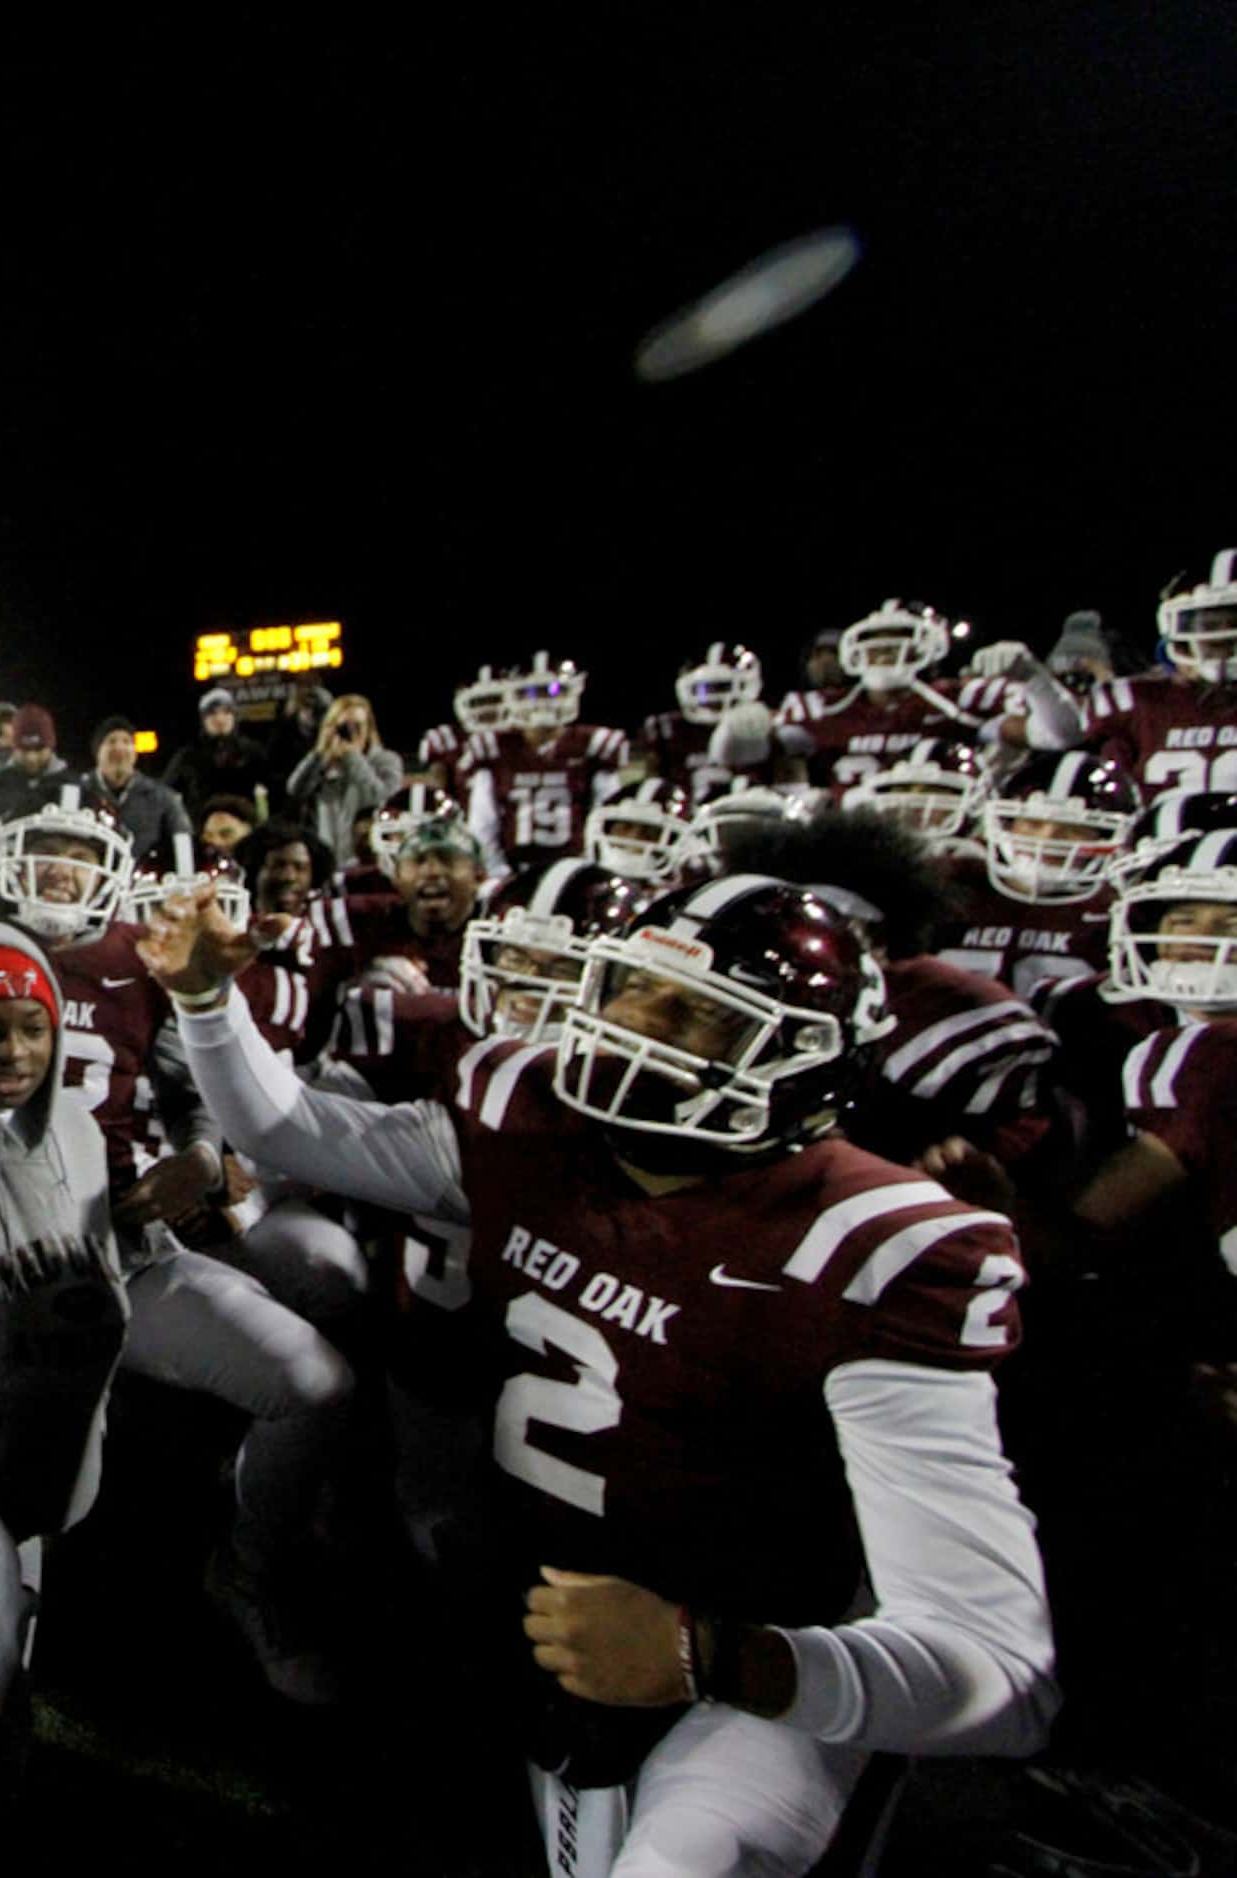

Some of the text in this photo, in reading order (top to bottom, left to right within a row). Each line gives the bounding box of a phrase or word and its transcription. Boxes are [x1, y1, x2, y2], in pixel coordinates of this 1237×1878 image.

[507, 788, 572, 847] 19
[1017, 929, 1071, 953] OAK
[62, 999, 97, 1029] AK
[501, 1224, 582, 1291] RED
[577, 1271, 682, 1346] OAK
[959, 1253, 1025, 1346] 2
[493, 1291, 623, 1518] 2
